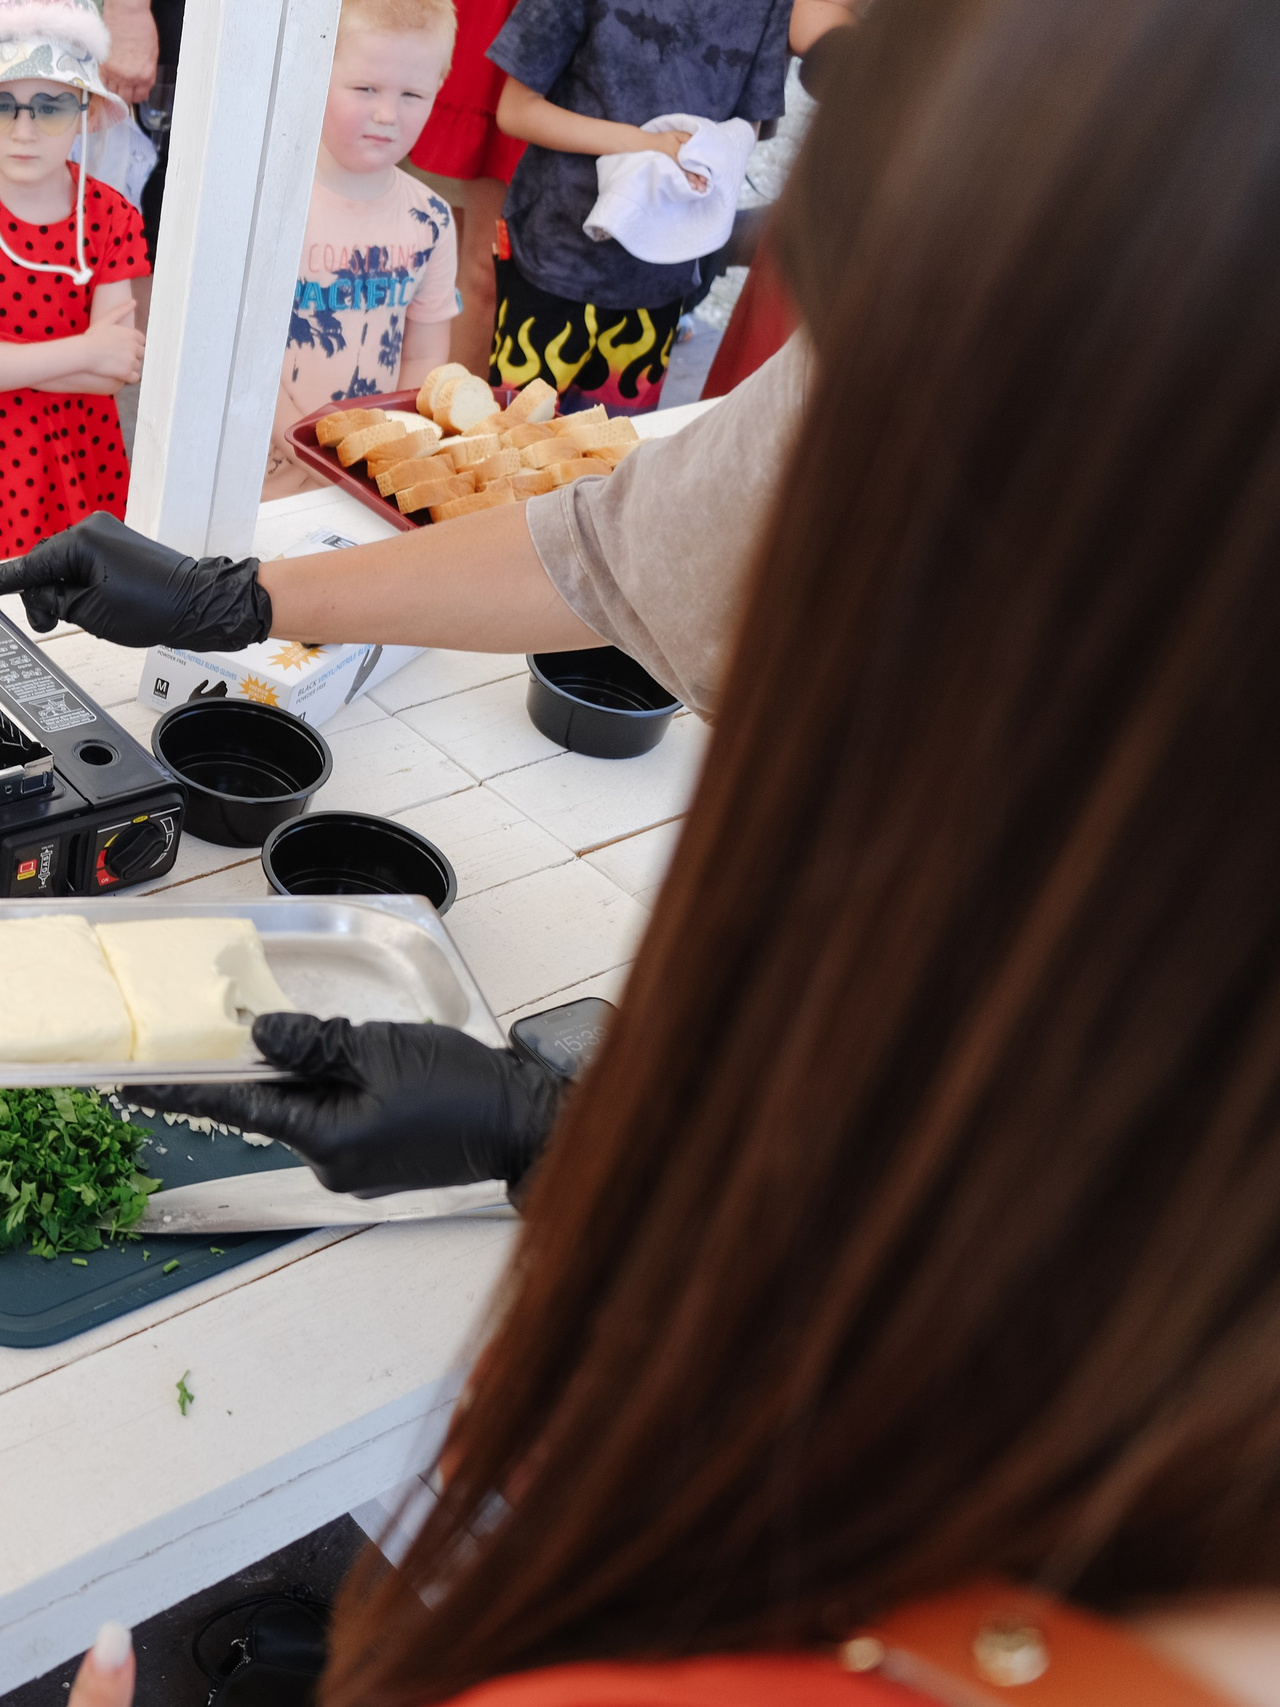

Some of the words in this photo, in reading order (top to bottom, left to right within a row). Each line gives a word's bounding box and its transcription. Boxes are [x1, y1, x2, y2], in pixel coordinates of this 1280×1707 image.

[175, 658, 187, 666] FREE
[156, 680, 166, 692] M
[297, 679, 318, 697] BLACK
